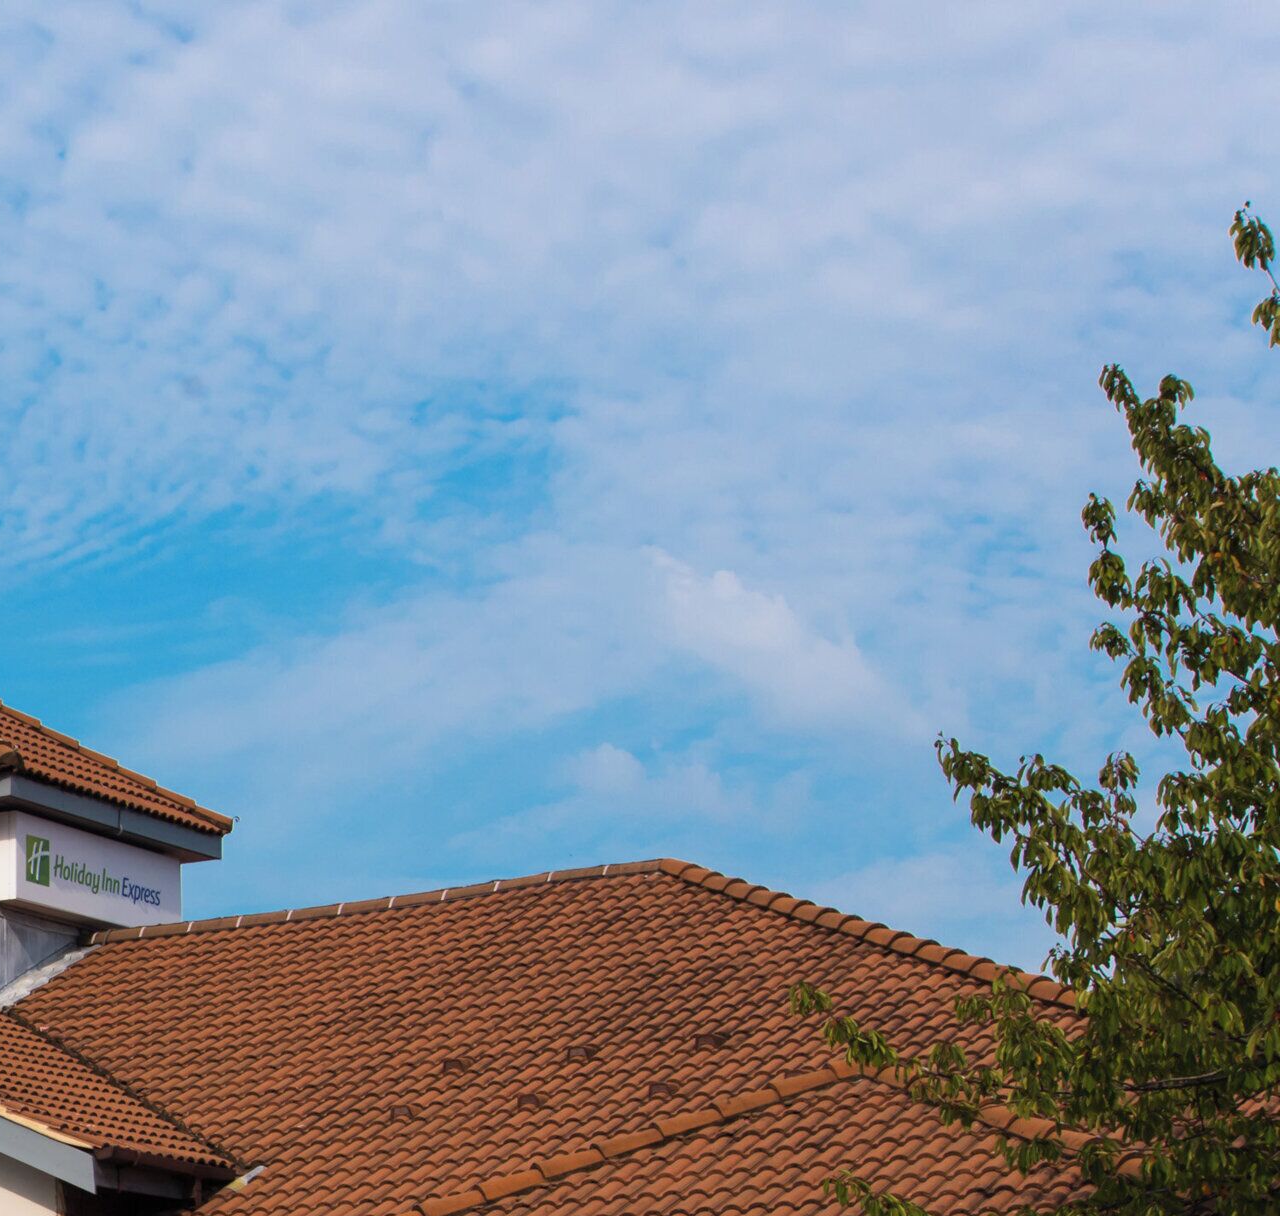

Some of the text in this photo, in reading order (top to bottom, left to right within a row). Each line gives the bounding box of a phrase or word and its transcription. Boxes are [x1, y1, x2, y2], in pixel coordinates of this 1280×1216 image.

[53, 854, 161, 906] Holiday Inn Express
